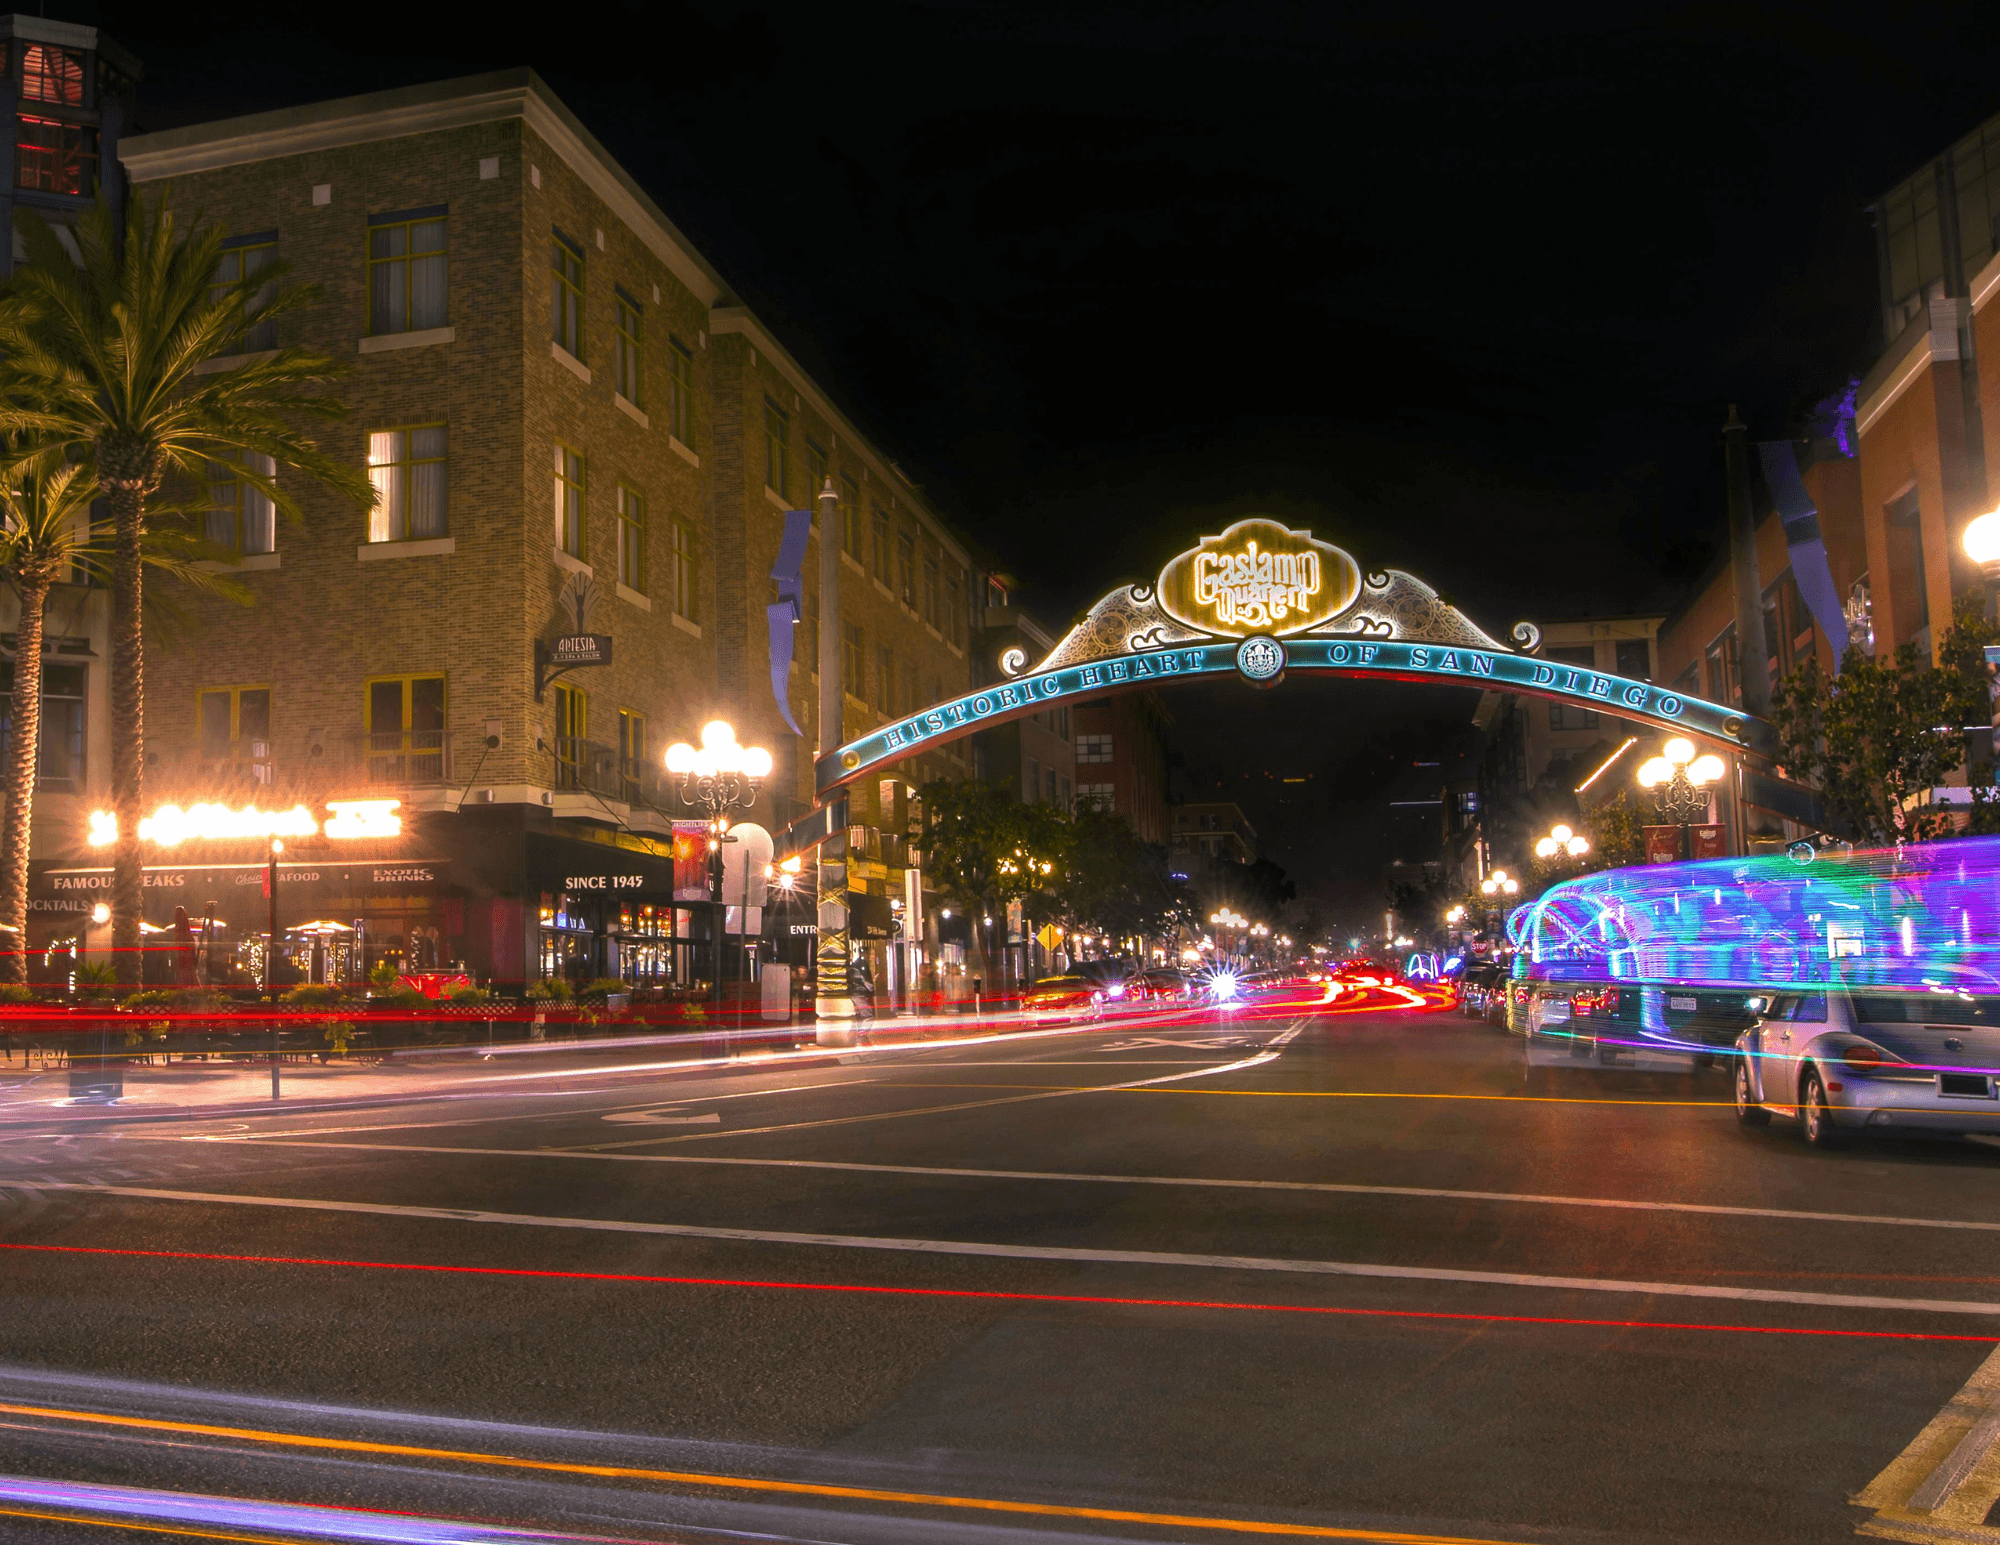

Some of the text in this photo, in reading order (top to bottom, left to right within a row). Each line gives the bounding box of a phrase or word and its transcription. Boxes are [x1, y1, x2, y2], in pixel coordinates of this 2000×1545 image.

[1194, 541, 1320, 605] Gaslamp
[1215, 583, 1311, 627] Quarter
[558, 637, 597, 652] ARTESIA
[885, 676, 1060, 750] HISTORIC
[1080, 651, 1205, 688] HEART
[1328, 643, 1378, 665] OF
[1410, 647, 1496, 676] SAN
[1531, 663, 1684, 718] DIEGO
[373, 868, 430, 876] EXOTIC
[373, 874, 434, 882] DRINKS
[142, 874, 185, 887] EAKS
[235, 872, 320, 886] Choic AFOOD
[565, 875, 643, 889] SINCE 1945
[26, 899, 88, 912] OCKTAILS
[790, 925, 818, 935] ENTR
[1472, 942, 1487, 950] STOP
